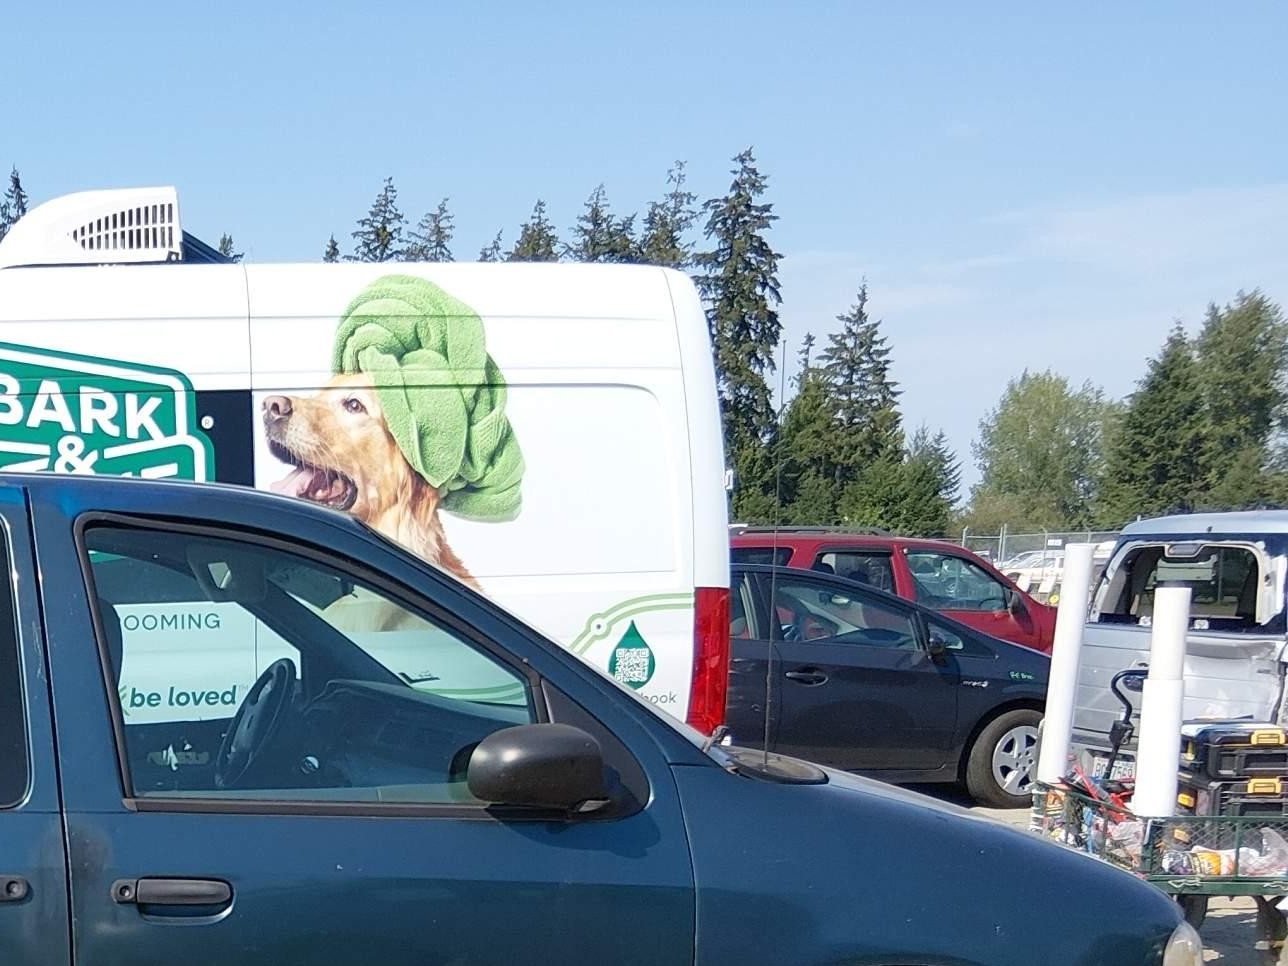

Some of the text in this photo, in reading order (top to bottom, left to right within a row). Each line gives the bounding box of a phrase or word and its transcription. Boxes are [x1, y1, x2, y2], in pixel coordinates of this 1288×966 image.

[54, 435, 98, 475] &
[124, 613, 220, 630] OOMING
[130, 685, 237, 707] be loved
